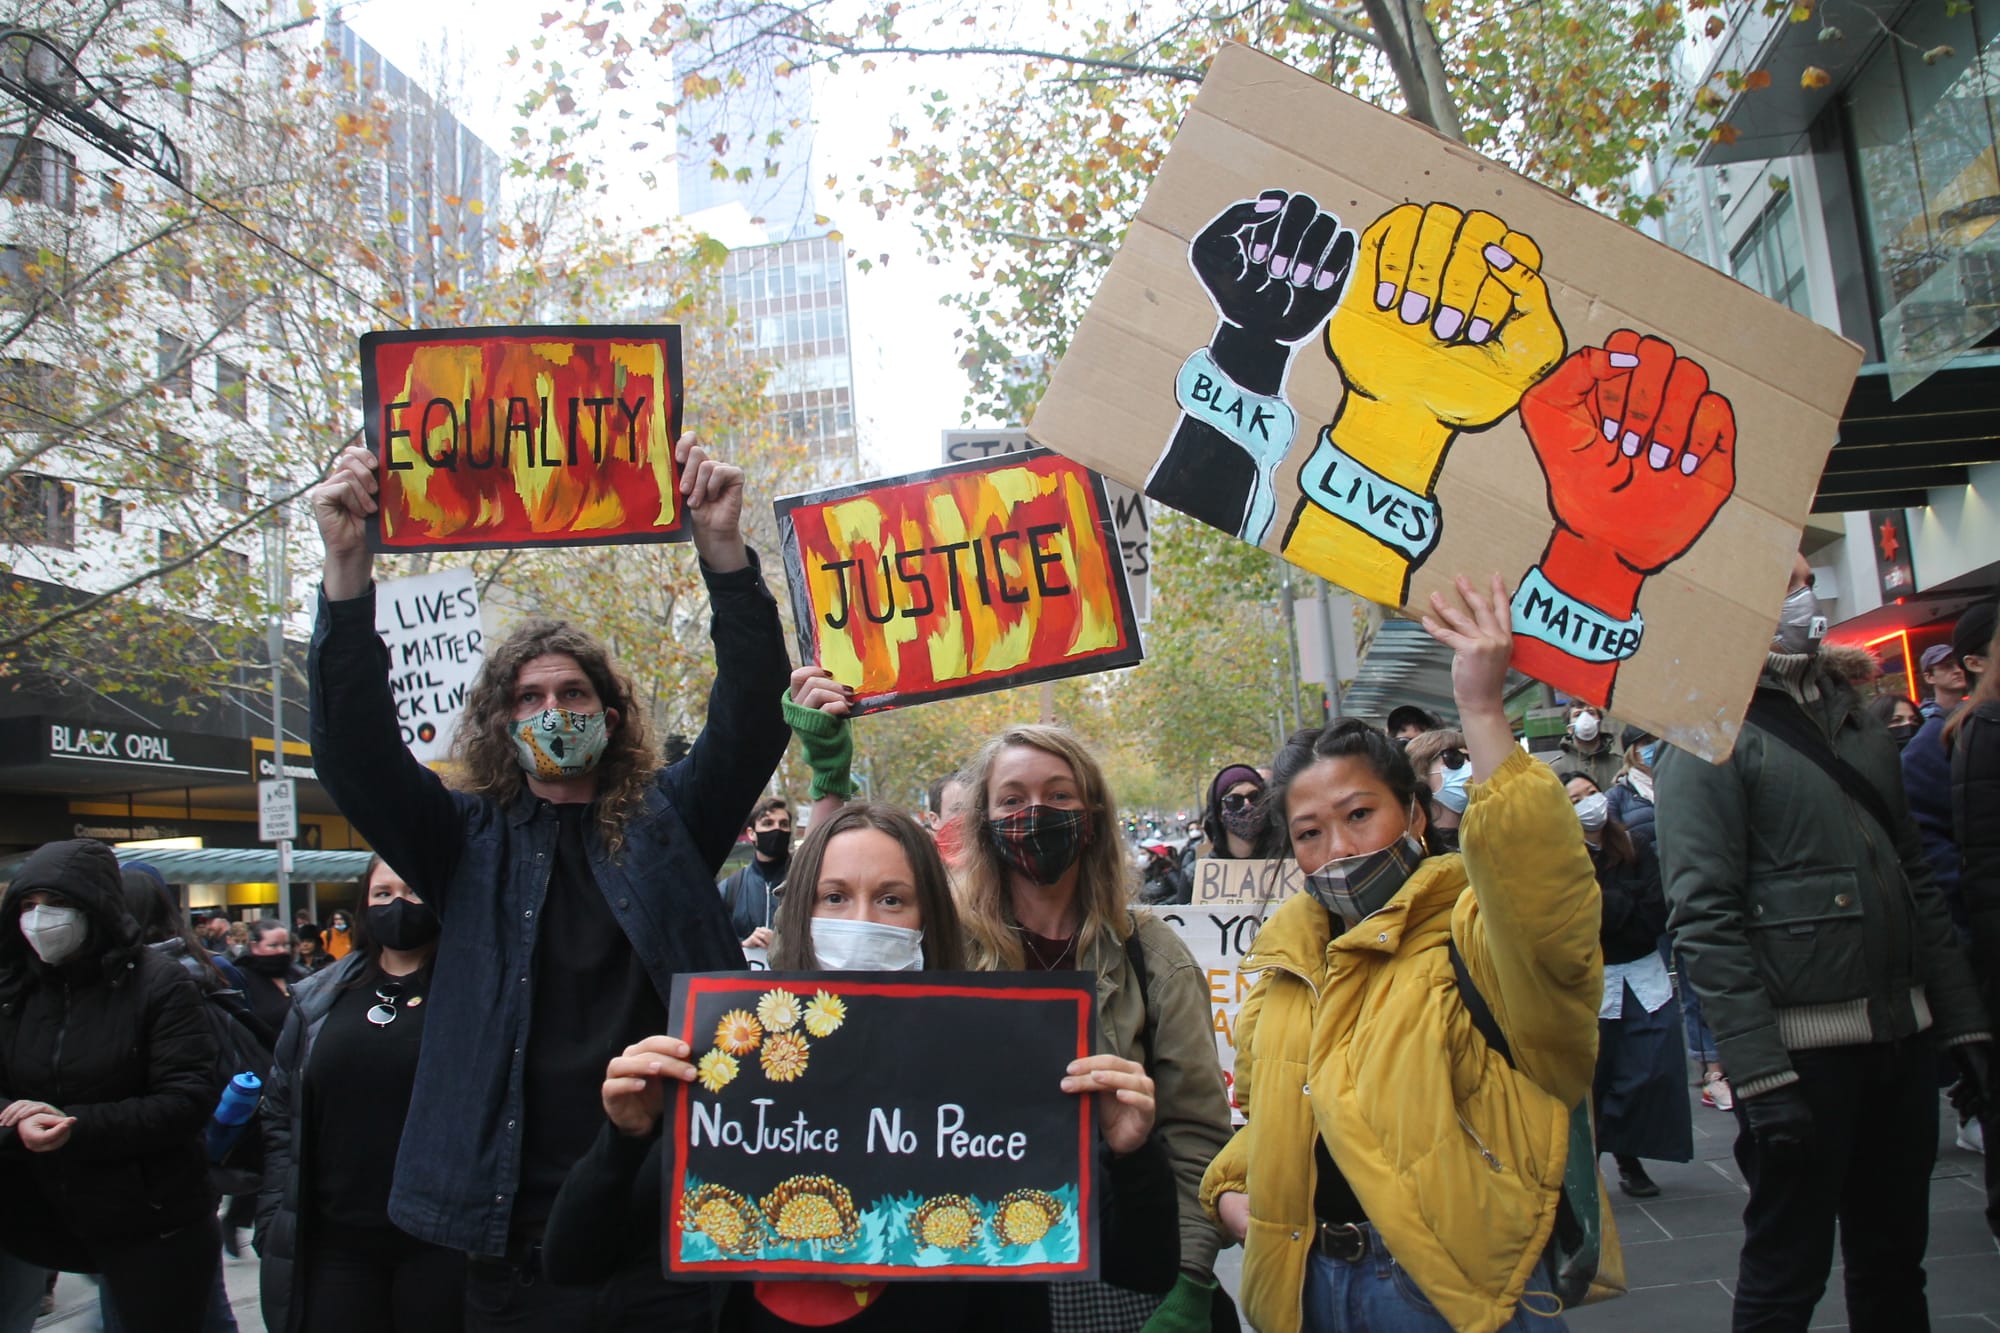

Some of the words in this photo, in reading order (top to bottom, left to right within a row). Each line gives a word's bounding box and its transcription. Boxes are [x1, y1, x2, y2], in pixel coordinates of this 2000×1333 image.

[384, 396, 646, 473] EQUALITY
[1190, 373, 1275, 442] BLAK
[1318, 460, 1430, 542] LIVES
[1523, 587, 1639, 657] MATTER
[820, 522, 1070, 629] JUSTICE
[395, 587, 477, 630] LIVES
[401, 629, 483, 668] MATTER
[389, 671, 444, 696] NTIL
[434, 682, 471, 714] LIV
[51, 724, 119, 757] BLACK
[125, 733, 175, 761] OPAL
[1202, 862, 1301, 900] BLACK
[690, 1100, 743, 1147] No
[741, 1097, 839, 1155] Justice
[866, 1106, 918, 1154] No
[936, 1102, 1027, 1161] Peace
